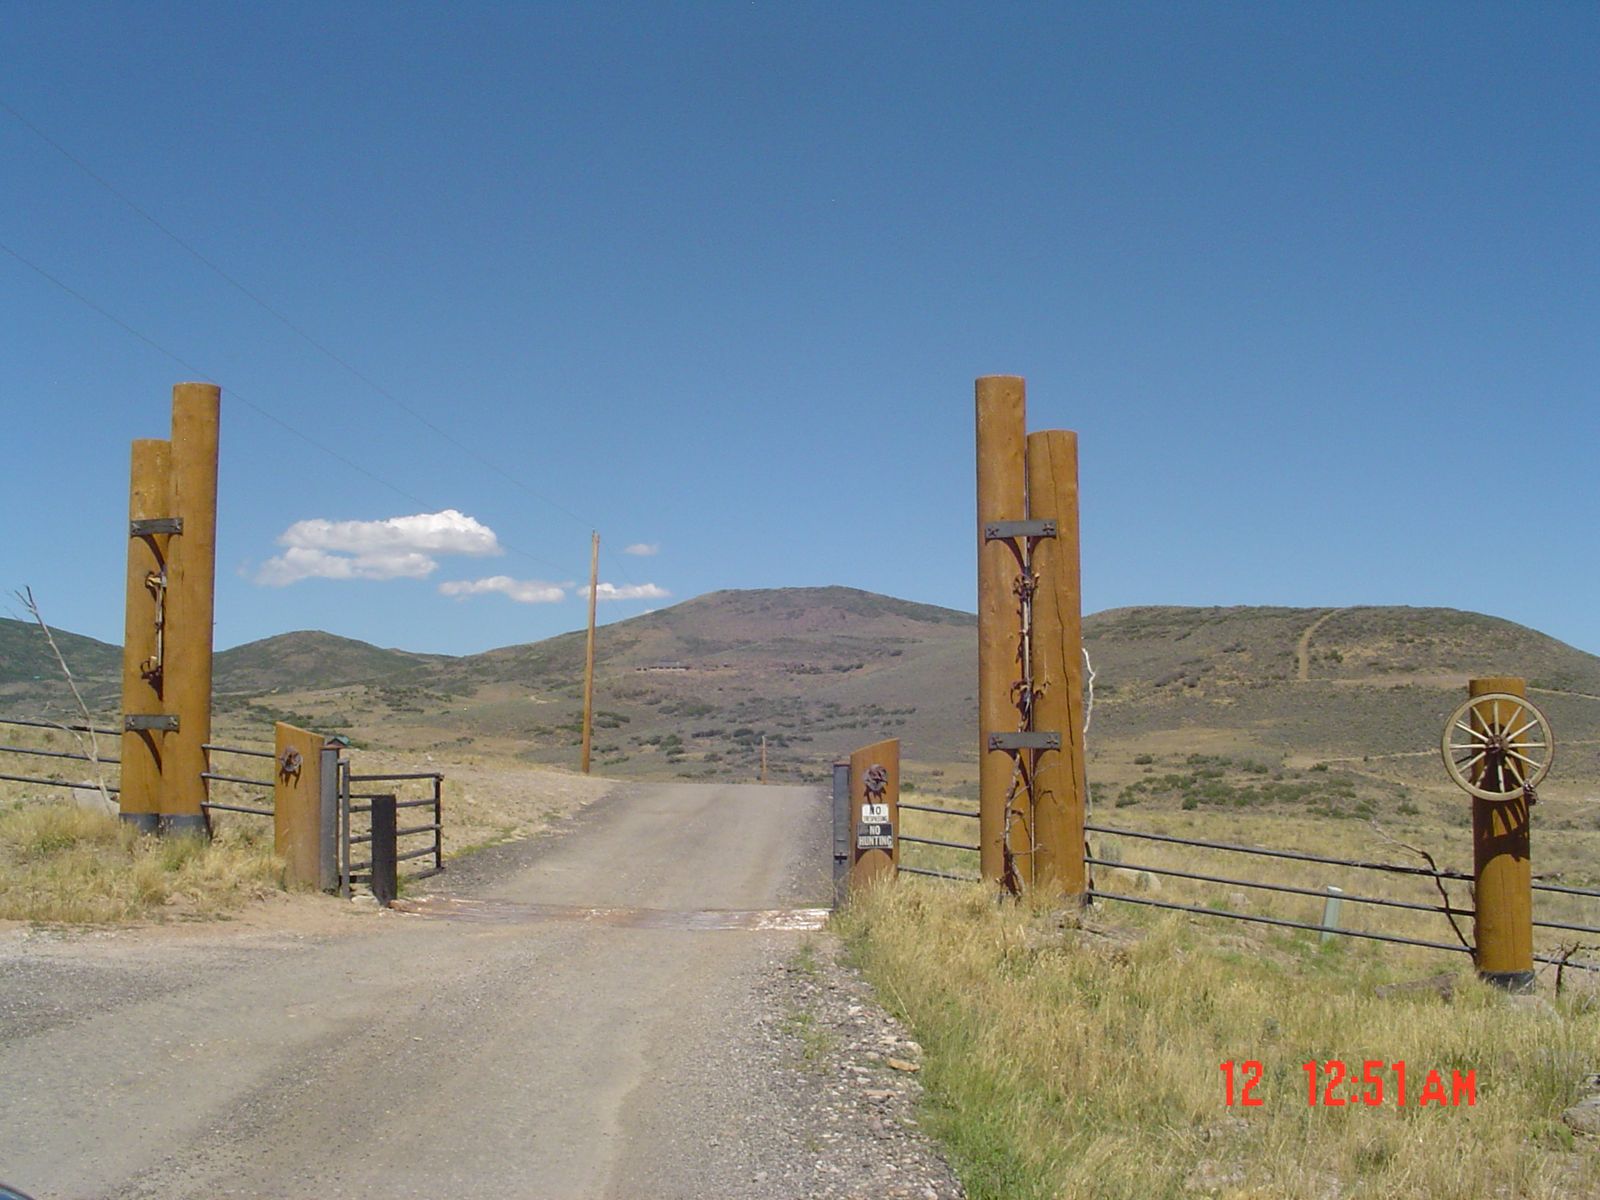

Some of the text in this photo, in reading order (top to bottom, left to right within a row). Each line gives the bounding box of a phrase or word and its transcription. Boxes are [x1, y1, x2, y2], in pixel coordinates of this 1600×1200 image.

[869, 806, 882, 815] NO
[869, 825, 881, 836] NO
[858, 835, 892, 846] HUNTING
